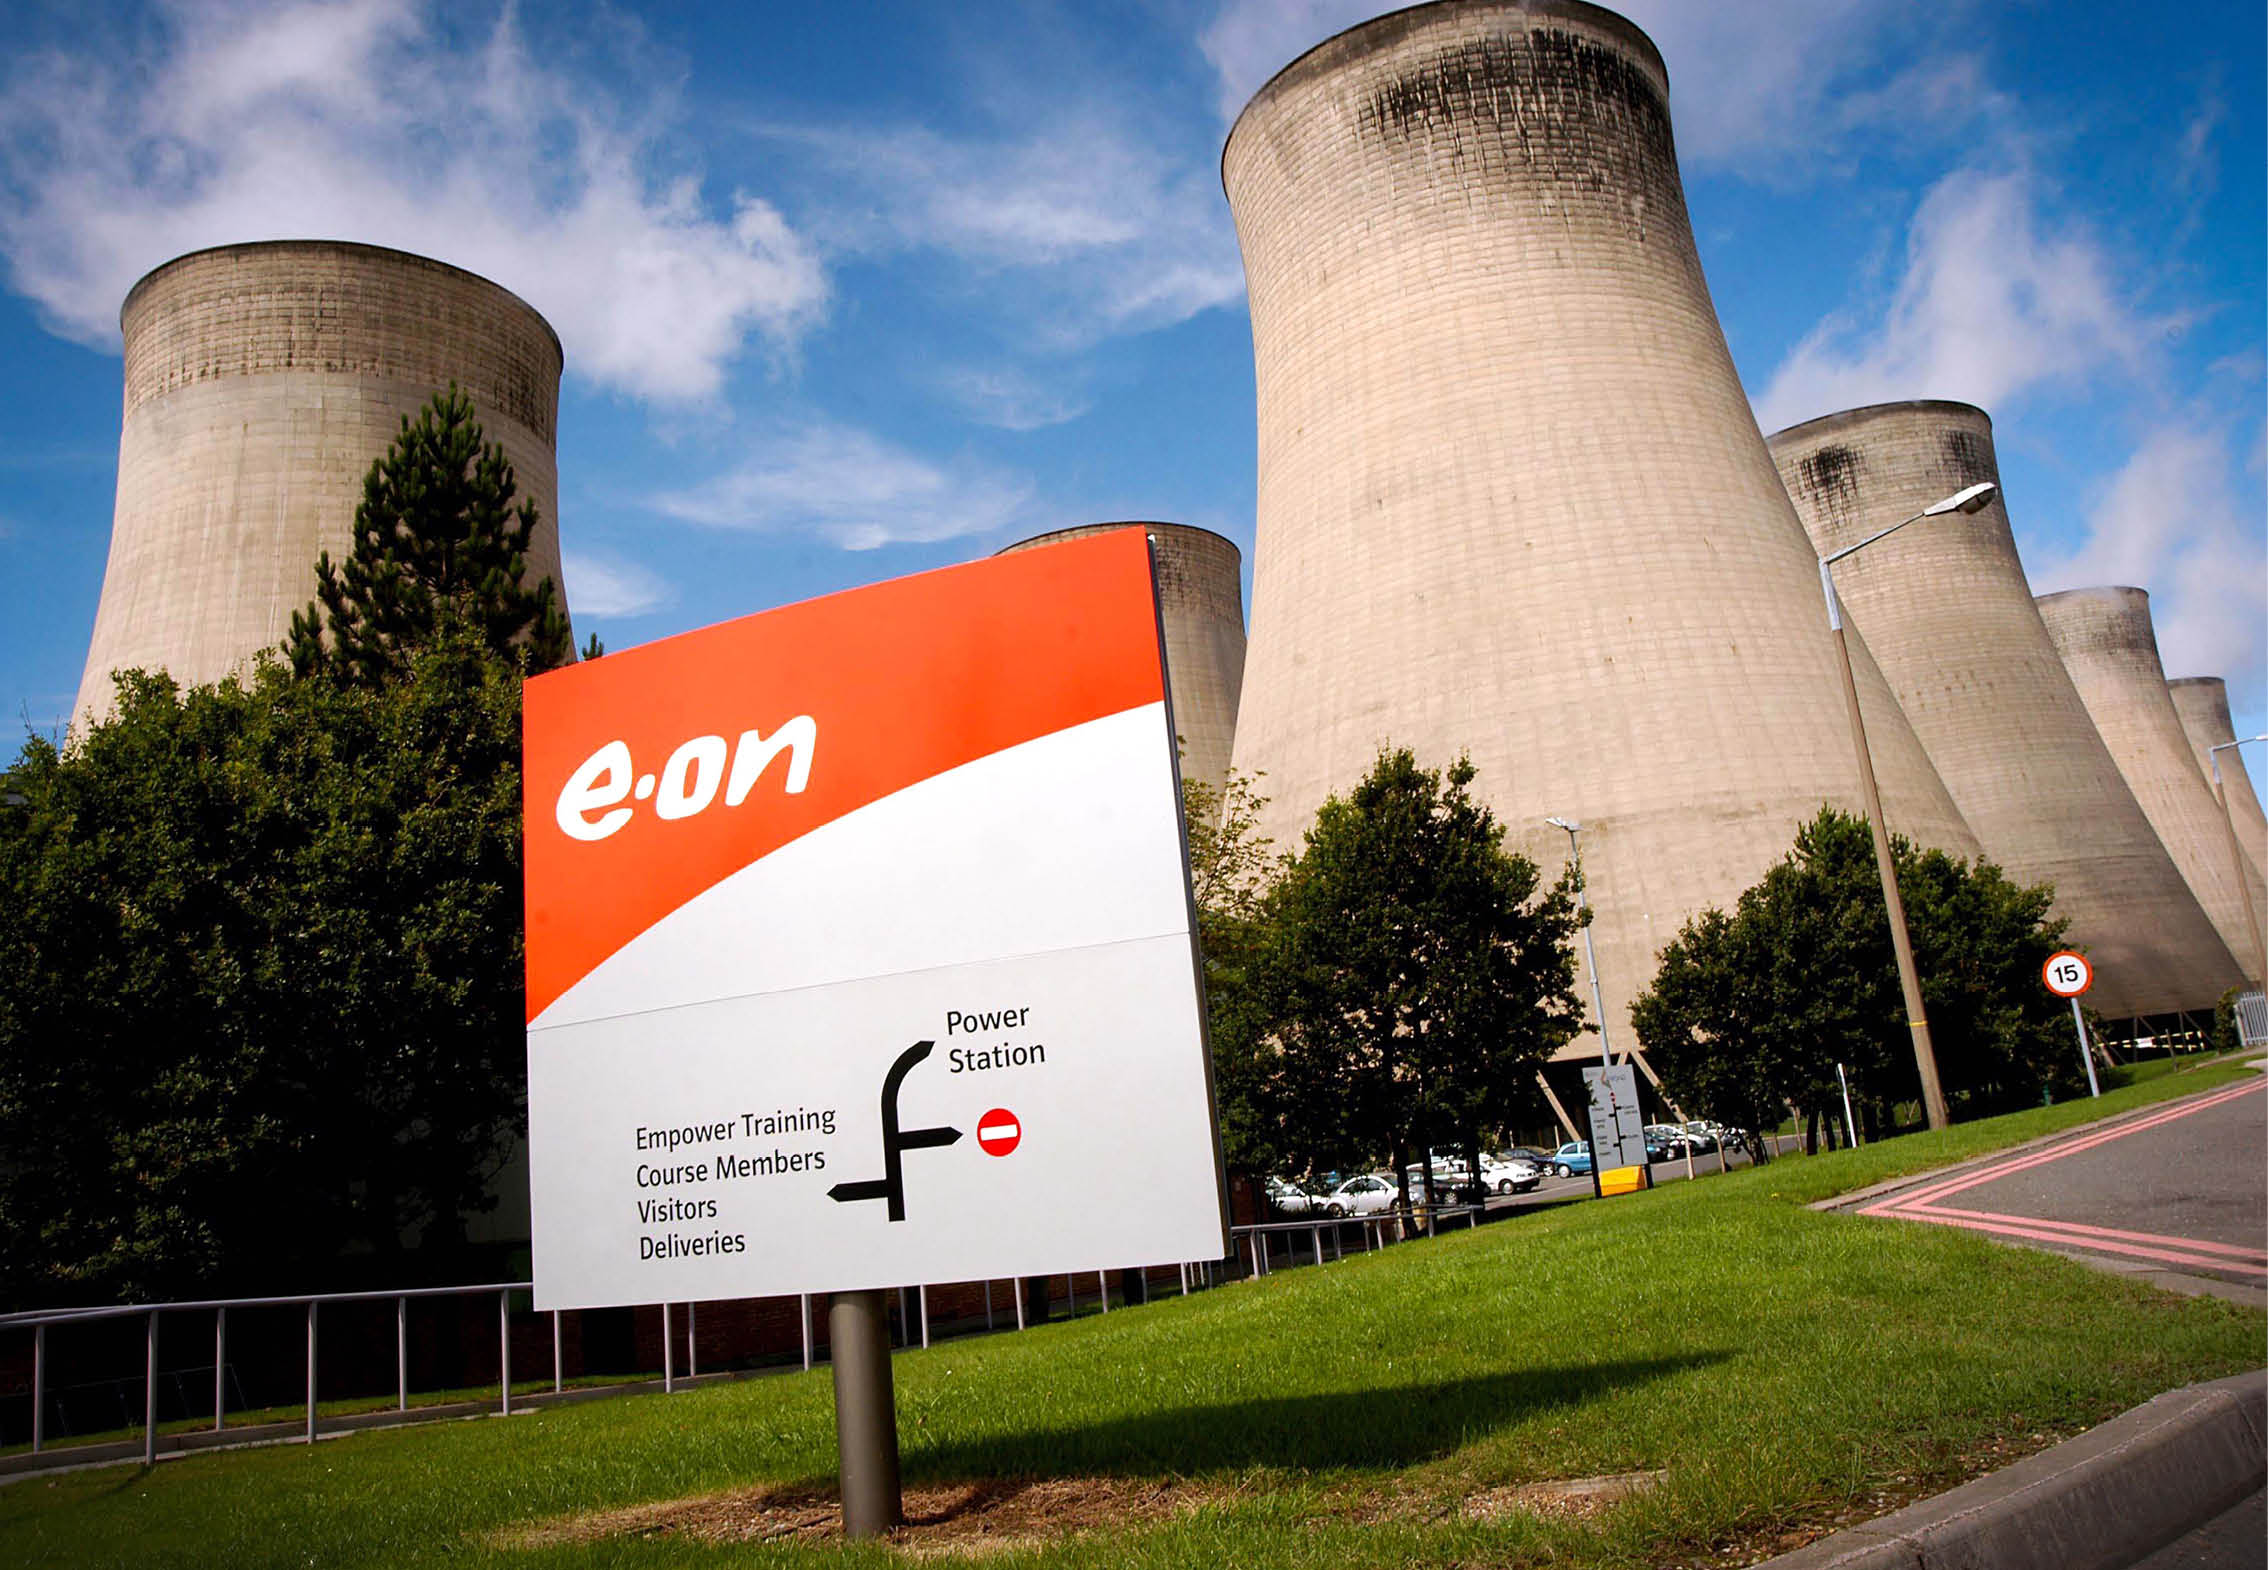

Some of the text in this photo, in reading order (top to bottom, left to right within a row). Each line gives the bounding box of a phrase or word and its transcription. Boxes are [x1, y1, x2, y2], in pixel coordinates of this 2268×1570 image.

[2054, 964, 2079, 984] 15
[946, 1007, 1030, 1036] Power
[949, 1042, 1046, 1074] Station
[637, 1107, 836, 1153] Empower Training
[636, 1149, 826, 1188] Course Members
[637, 1199, 718, 1224] Visitors
[639, 1230, 746, 1260] Deliveries
